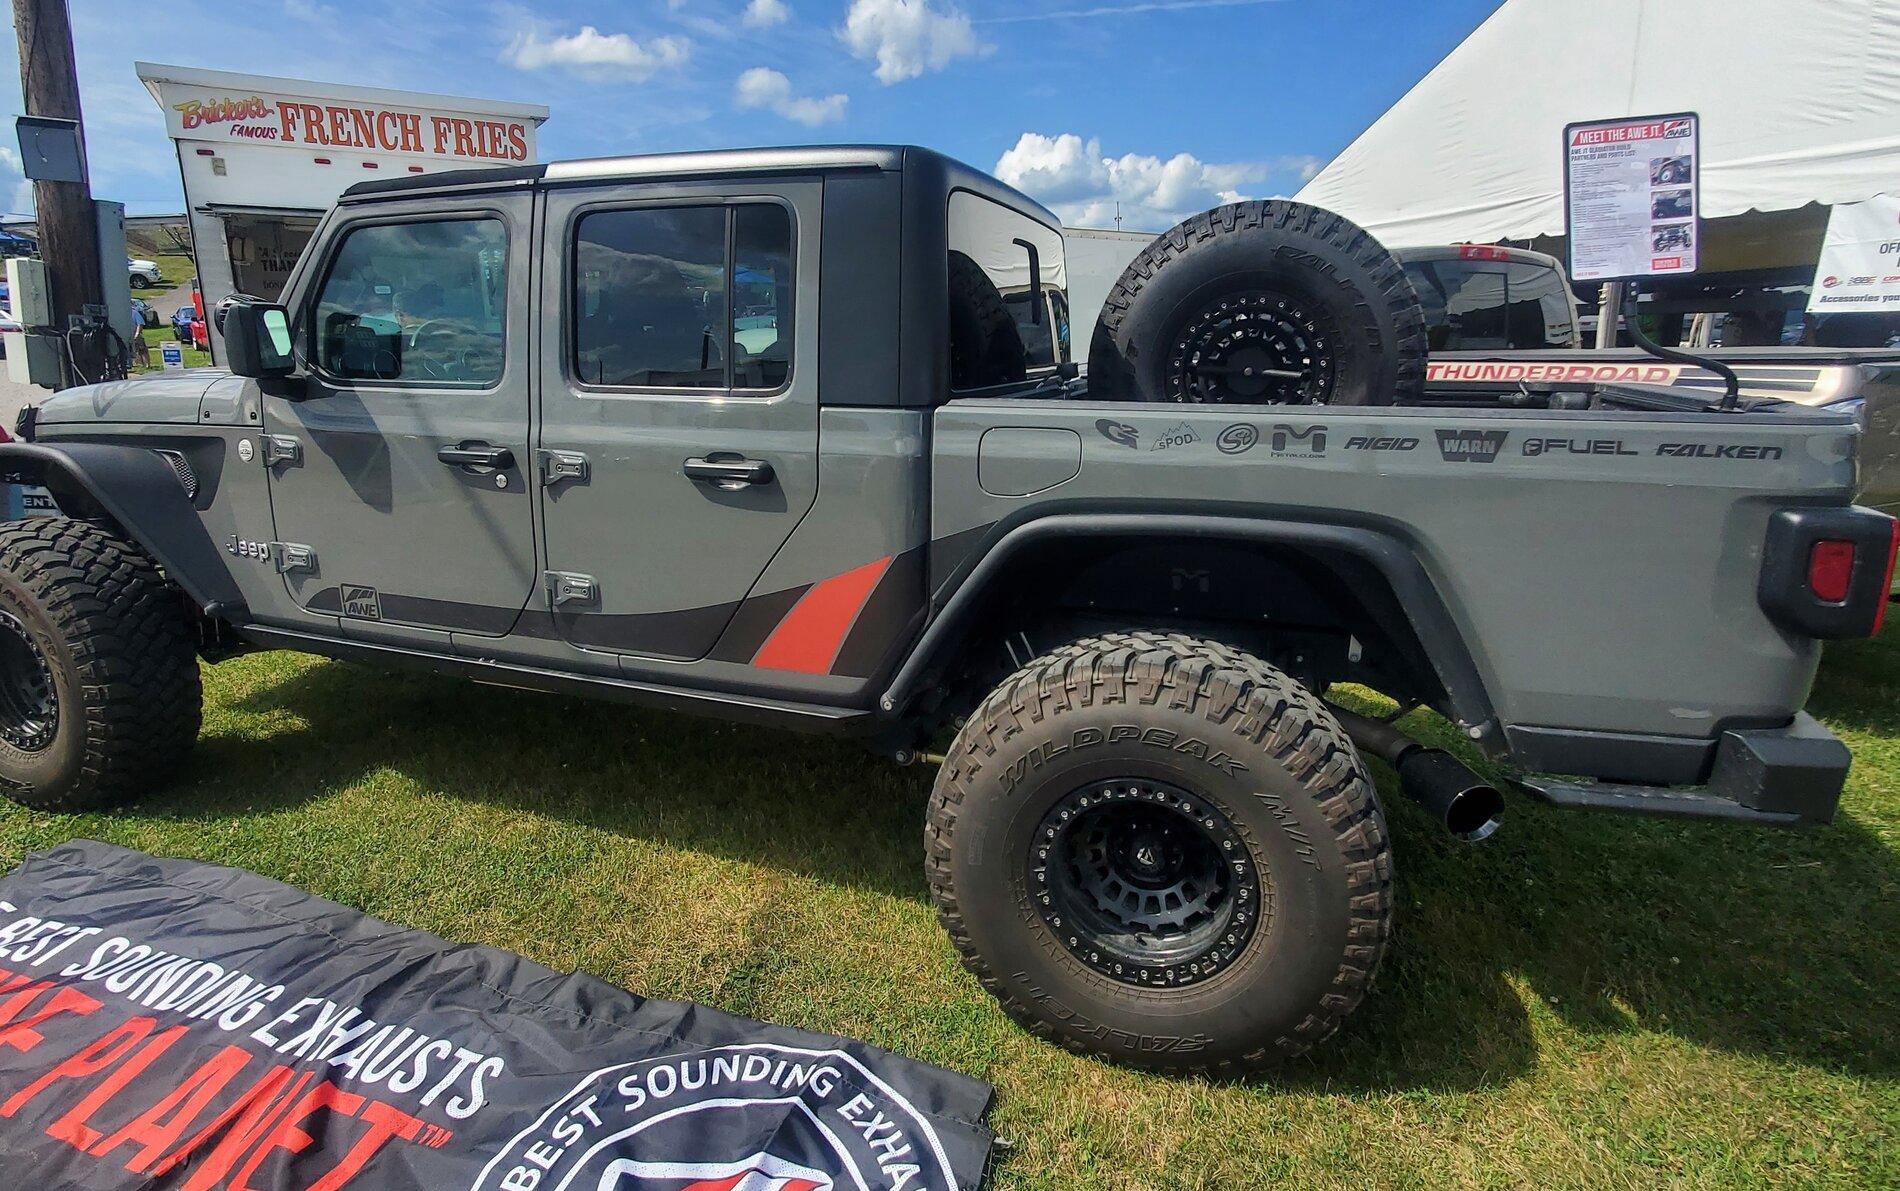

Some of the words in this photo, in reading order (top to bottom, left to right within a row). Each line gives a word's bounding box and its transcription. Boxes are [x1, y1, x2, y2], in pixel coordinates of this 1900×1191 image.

[173, 96, 274, 129] Bricker's
[230, 124, 277, 140] FAMOUS
[276, 102, 424, 152] FRENCH
[431, 116, 527, 161] FRIES
[1580, 130, 1605, 143] MEET
[1606, 128, 1626, 141] THE
[1627, 126, 1649, 139] AWE
[1820, 295, 1880, 303] Accessories
[1427, 364, 1671, 383] THUNDERROAD
[1343, 436, 1420, 451] RIGID
[1443, 439, 1497, 454] WARN
[1543, 439, 1638, 456] FUEL
[1655, 442, 1784, 461] FALKEN
[226, 534, 271, 563] Jeep
[998, 723, 1250, 796] WILDPEAK
[0, 916, 104, 967] BEST
[60, 936, 285, 1032] SOUNDING
[250, 995, 505, 1120] EXHAUSTS
[499, 1094, 603, 1191] BEST
[616, 1054, 843, 1112] SOUNDING
[835, 1092, 927, 1191] EXHA
